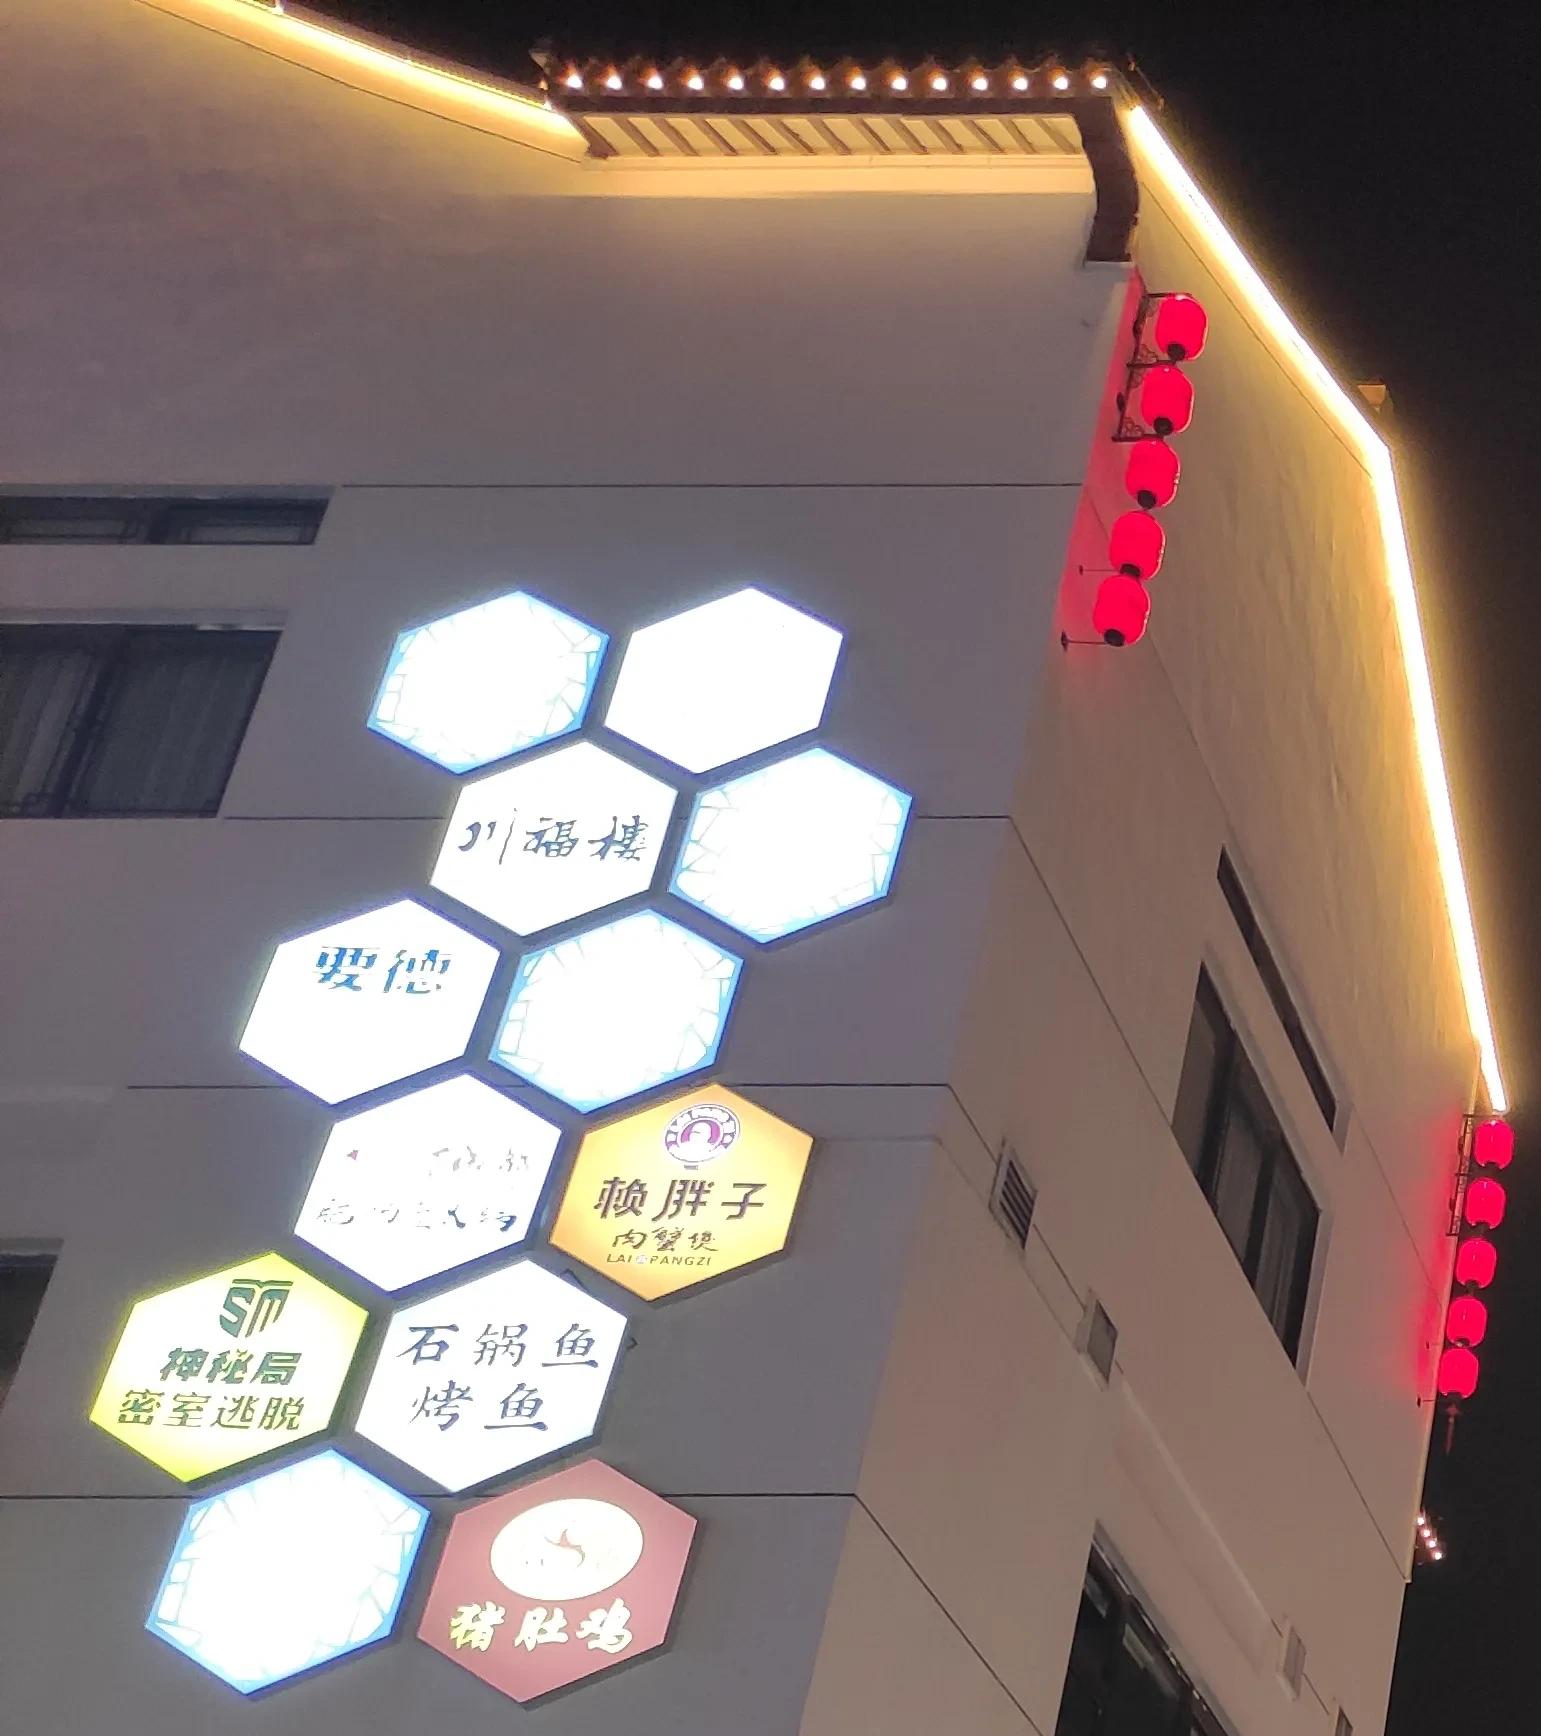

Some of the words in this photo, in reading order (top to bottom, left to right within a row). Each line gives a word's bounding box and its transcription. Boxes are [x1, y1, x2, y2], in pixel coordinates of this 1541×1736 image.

[594, 1175, 767, 1223] 赖胖子
[606, 1253, 632, 1264] LAI
[649, 1254, 712, 1266] PANGZI
[160, 1347, 302, 1386] 神秘局
[396, 1322, 600, 1370] 石锅鱼
[117, 1388, 306, 1431] 密室逃脱
[410, 1382, 549, 1433] 烤鱼
[449, 1598, 634, 1654] 猪肚鸡
